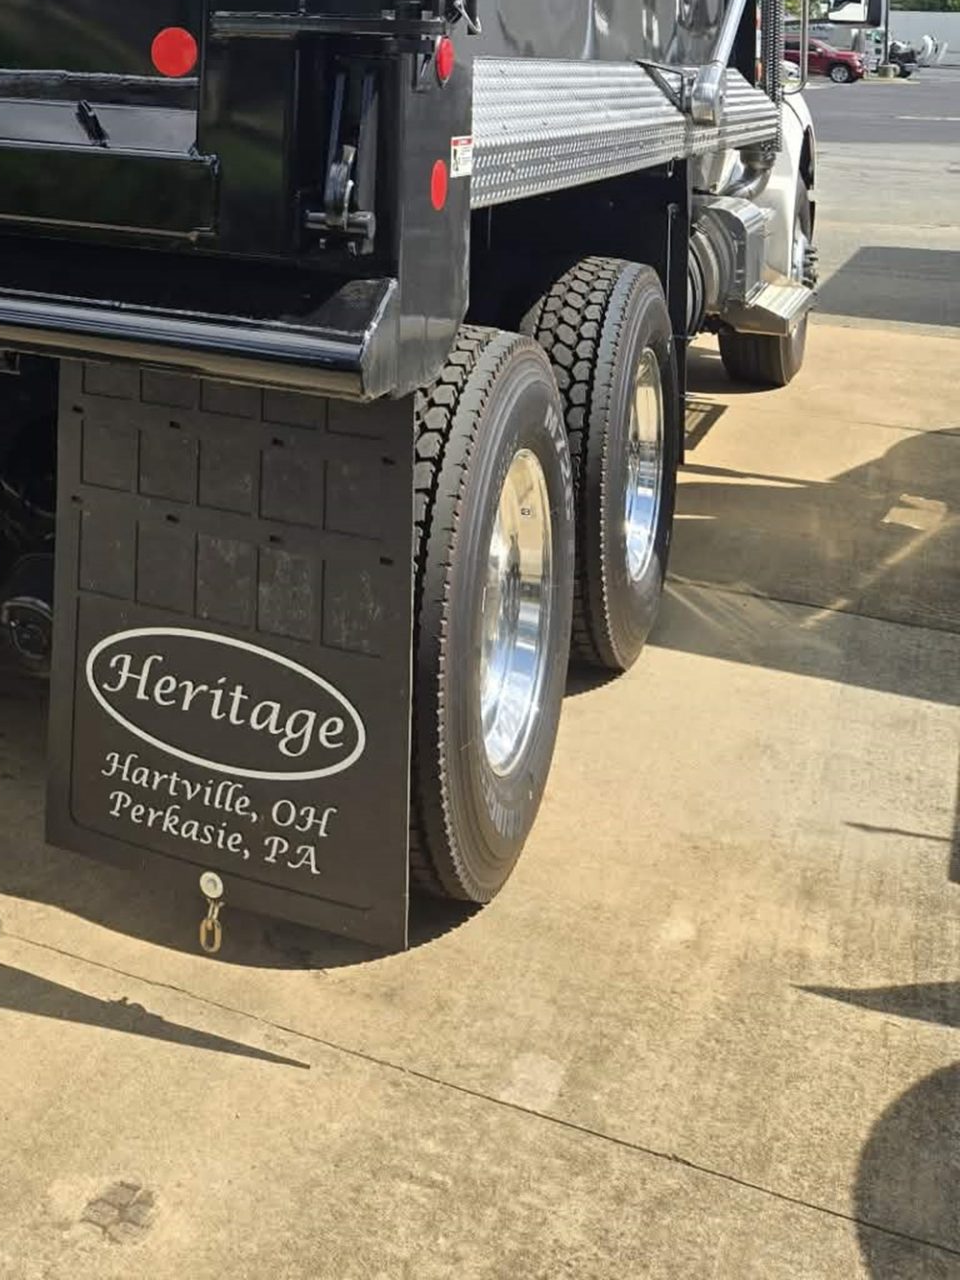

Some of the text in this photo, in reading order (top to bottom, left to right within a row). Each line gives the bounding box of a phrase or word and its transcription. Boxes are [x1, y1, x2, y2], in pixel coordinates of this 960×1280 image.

[102, 654, 345, 757] Heritage
[101, 752, 337, 838] Hartville, OH
[109, 791, 321, 875] Perkasie, PA
